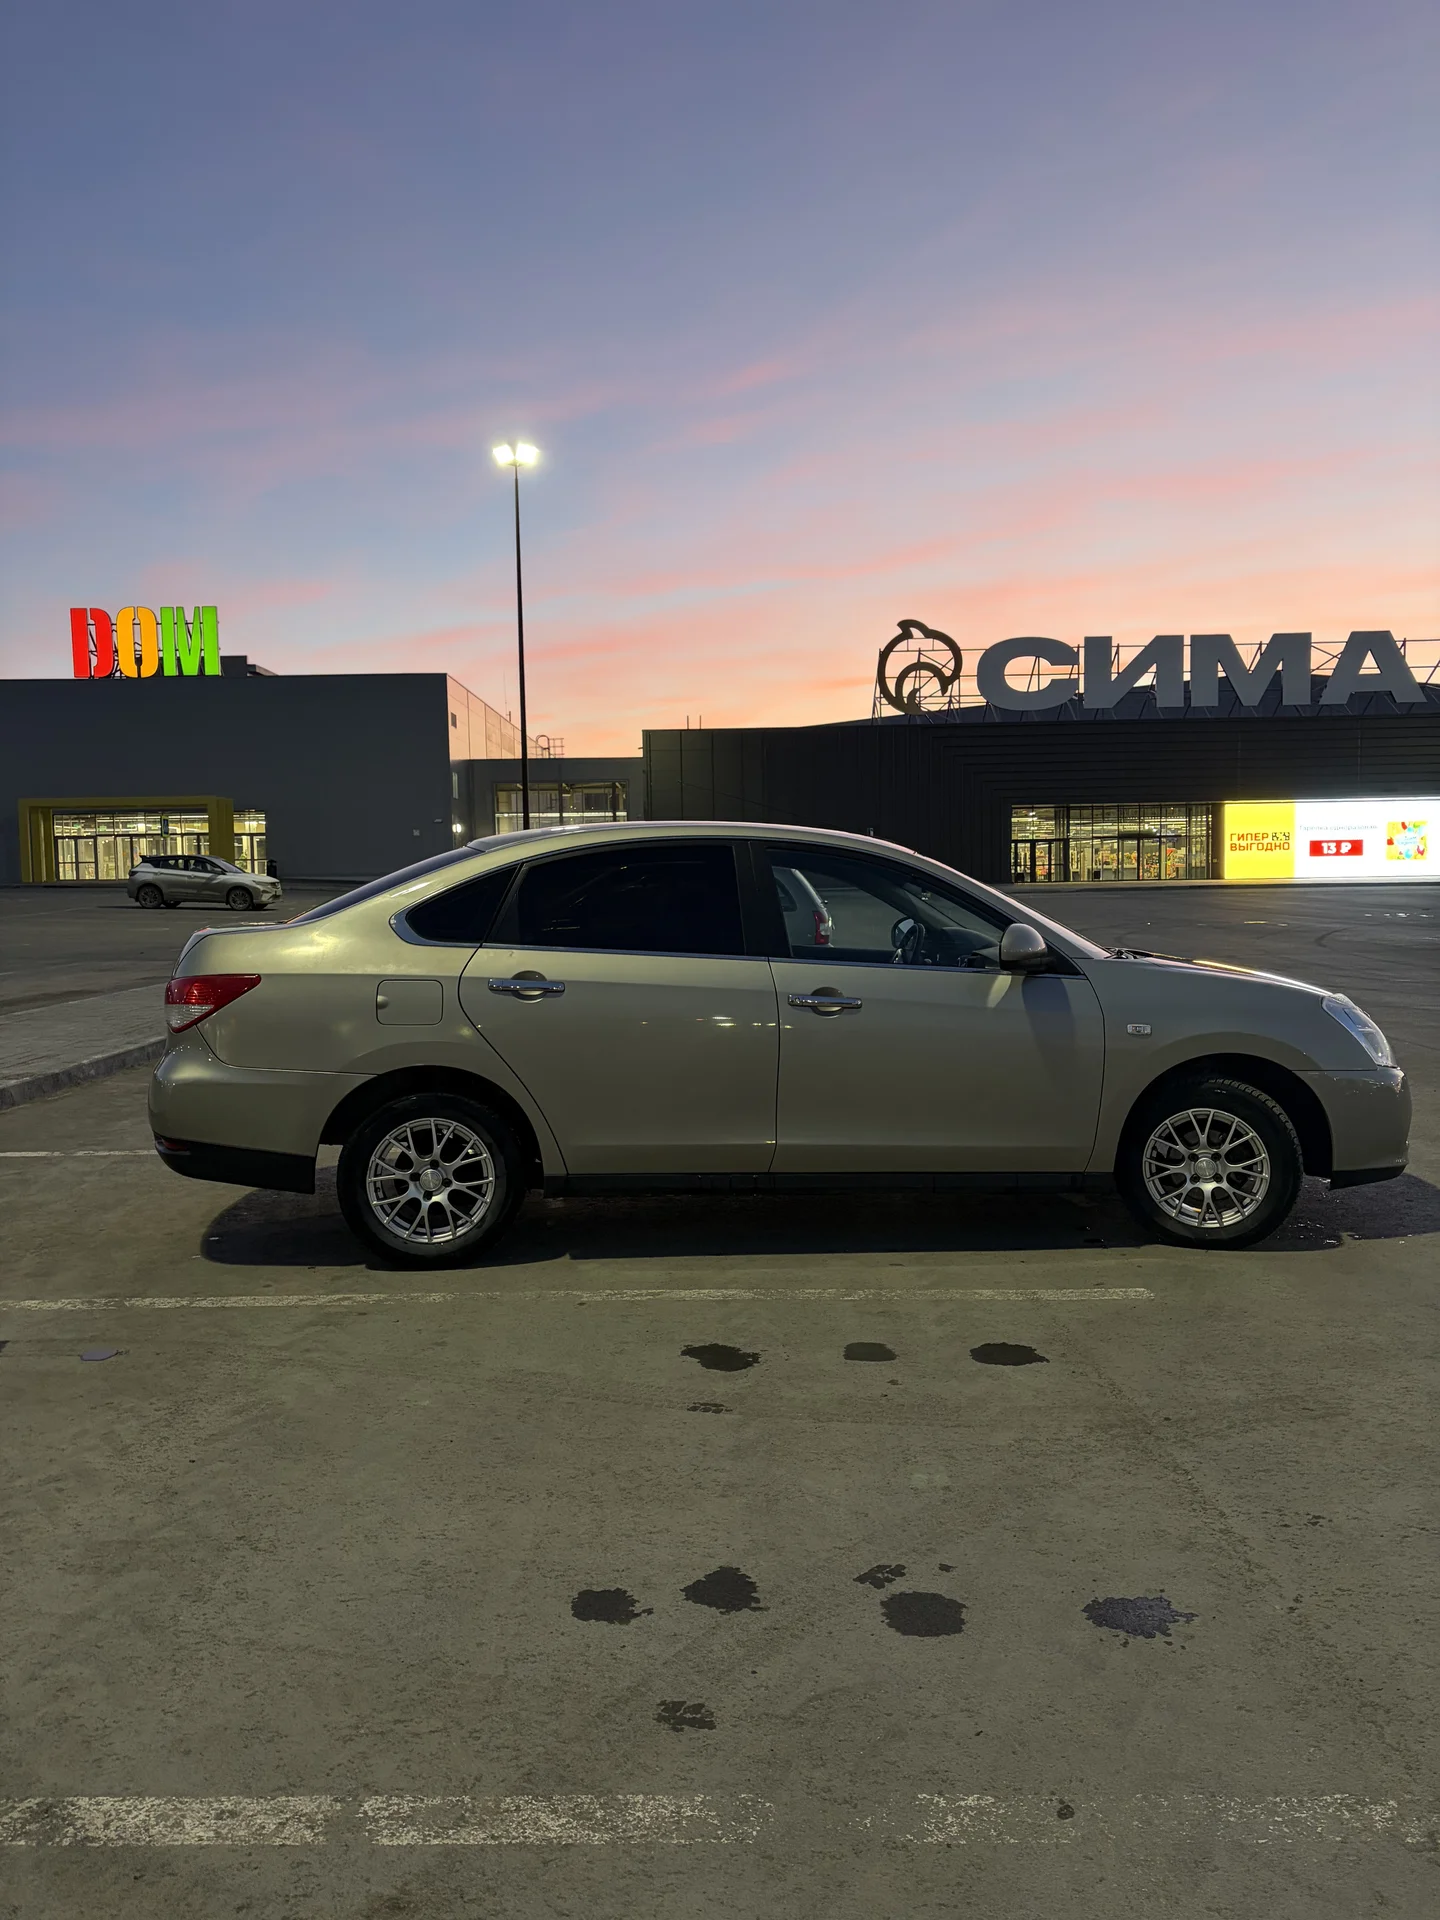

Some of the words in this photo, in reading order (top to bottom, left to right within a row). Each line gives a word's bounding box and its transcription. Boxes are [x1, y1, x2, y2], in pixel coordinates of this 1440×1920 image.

[70, 606, 221, 678] DOM
[976, 630, 1428, 711] СИМА
[1230, 832, 1269, 841] ГИПЕР
[1230, 842, 1290, 852] ВЫГОДНО
[1321, 842, 1337, 854] 13
